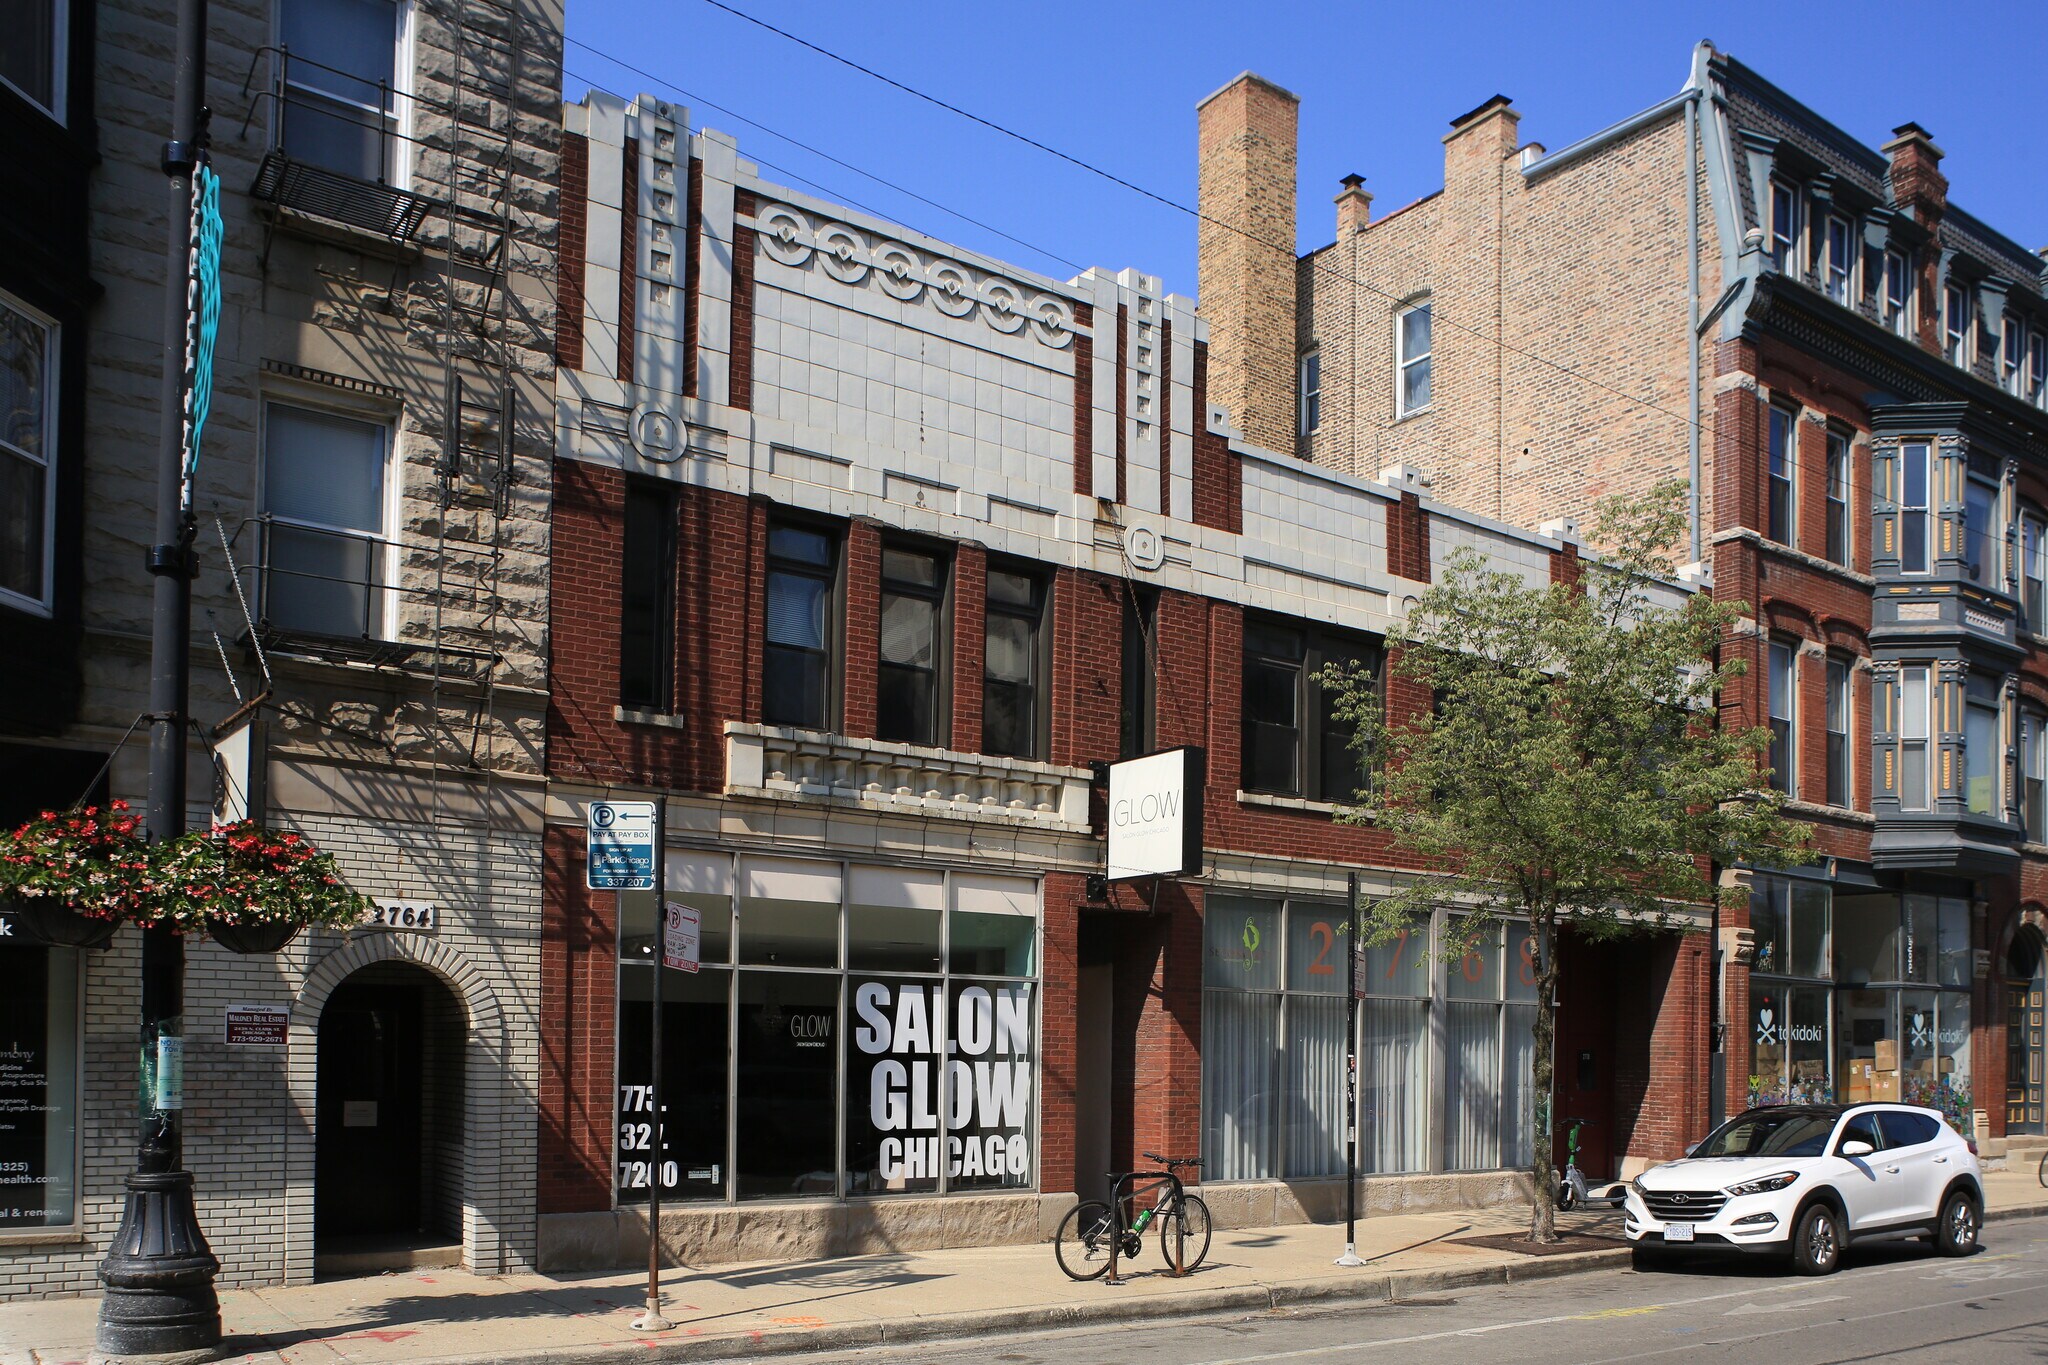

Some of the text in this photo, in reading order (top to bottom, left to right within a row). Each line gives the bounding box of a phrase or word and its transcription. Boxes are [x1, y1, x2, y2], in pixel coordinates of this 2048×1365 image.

[1114, 788, 1180, 827] GLOW
[602, 855, 650, 866] ParkChicago
[606, 878, 625, 887] 337
[628, 878, 646, 887] 207
[373, 905, 431, 928] 2764
[681, 960, 696, 971] ZONE
[791, 1014, 831, 1038] GLOW
[855, 982, 1029, 1056] SALON
[1778, 1025, 1822, 1041] tokidoki
[870, 1059, 1030, 1131] GLOW
[621, 1123, 669, 1150] 32.
[879, 1134, 1028, 1180] CHICAGO
[24, 1209, 63, 1217] renew.
